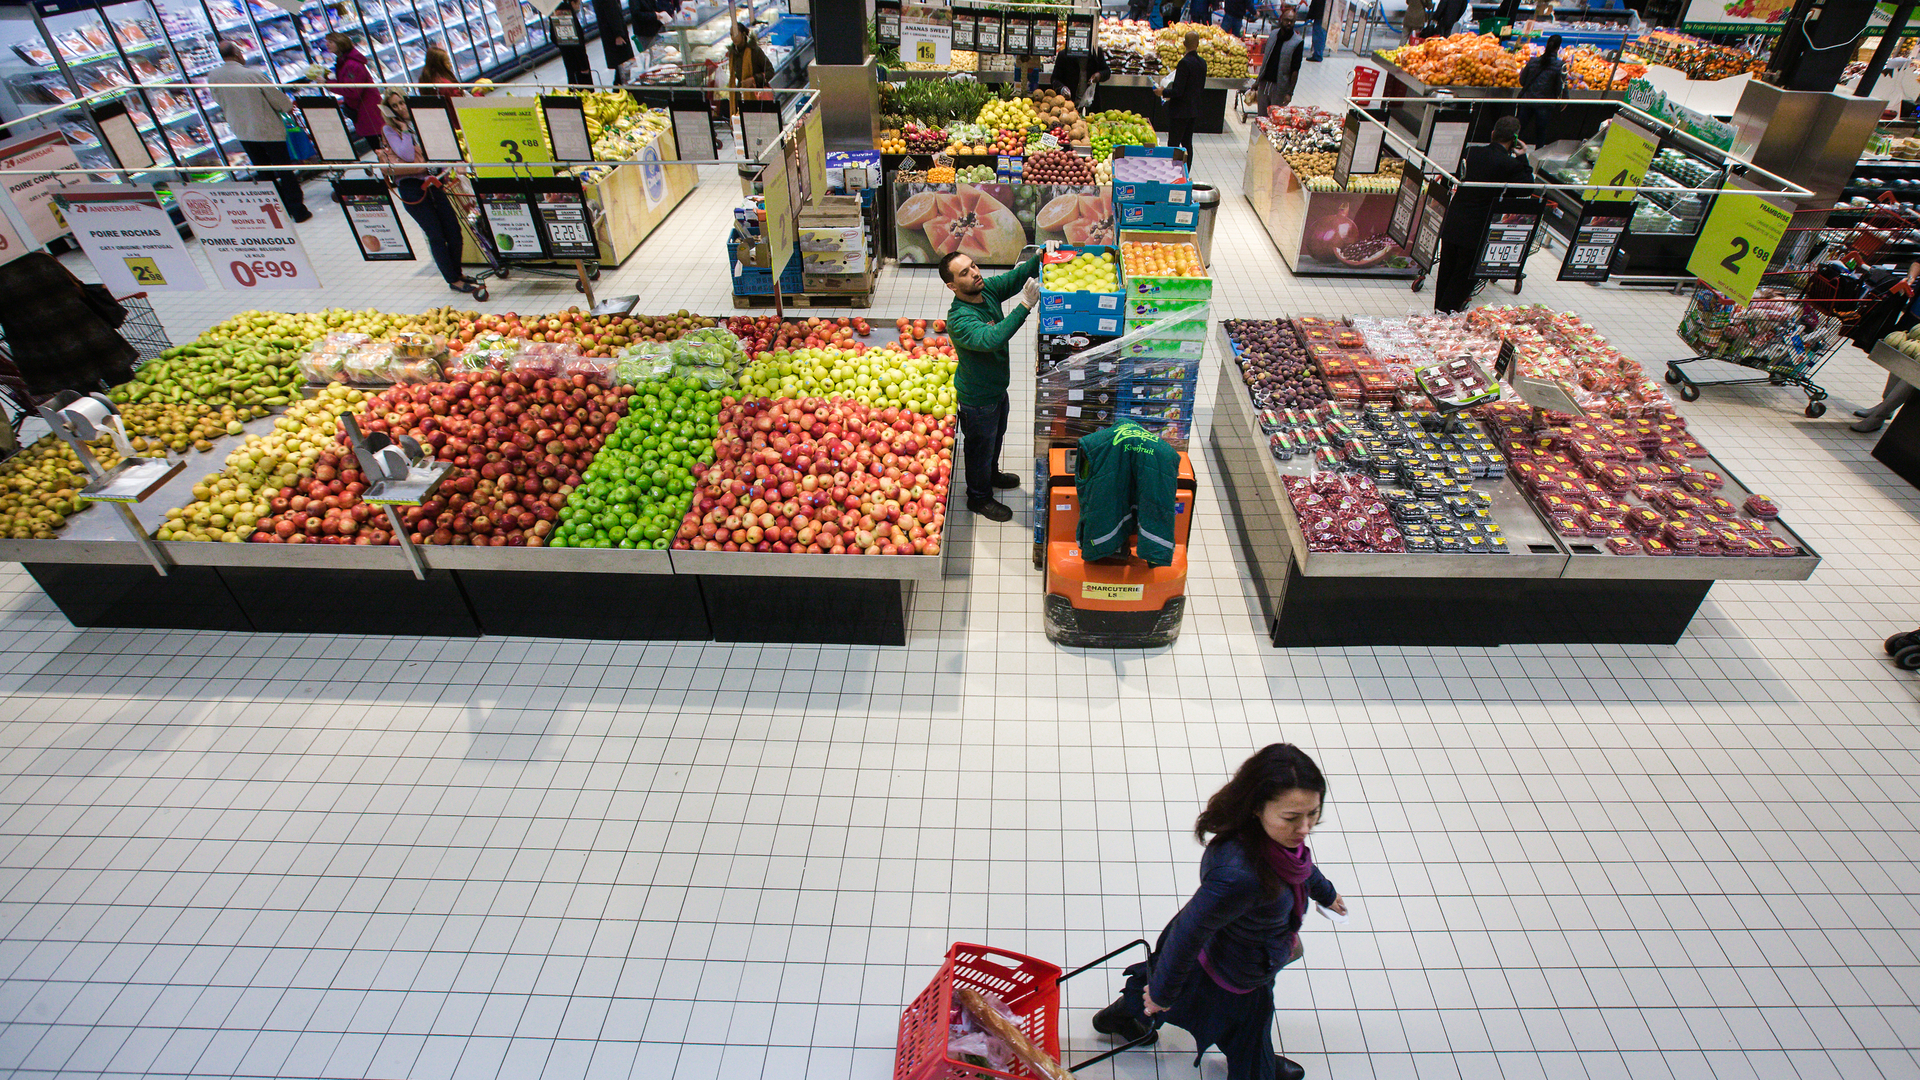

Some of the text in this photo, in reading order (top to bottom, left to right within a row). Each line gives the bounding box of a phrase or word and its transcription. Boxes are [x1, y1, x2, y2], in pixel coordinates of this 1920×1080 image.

[16, 147, 55, 165] ANNIVERSAIRE
[9, 179, 34, 193] POIRE
[89, 204, 142, 213] ANNIVERSAIRE
[1759, 203, 1791, 223] FRAMBOISE
[89, 229, 161, 238] POIRE ROCHAS
[552, 225, 577, 241] 2.28
[200, 237, 296, 246] POMME JONAGOLD
[1489, 246, 1512, 260] 4.48
[1574, 248, 1600, 264] 3.98
[1720, 236, 1770, 276] 2€98
[229, 260, 298, 287] 0€99
[1112, 423, 1159, 446] Zespri
[1124, 443, 1155, 456] Kiwifruit
[1086, 584, 1141, 592] CHARCUTERIE
